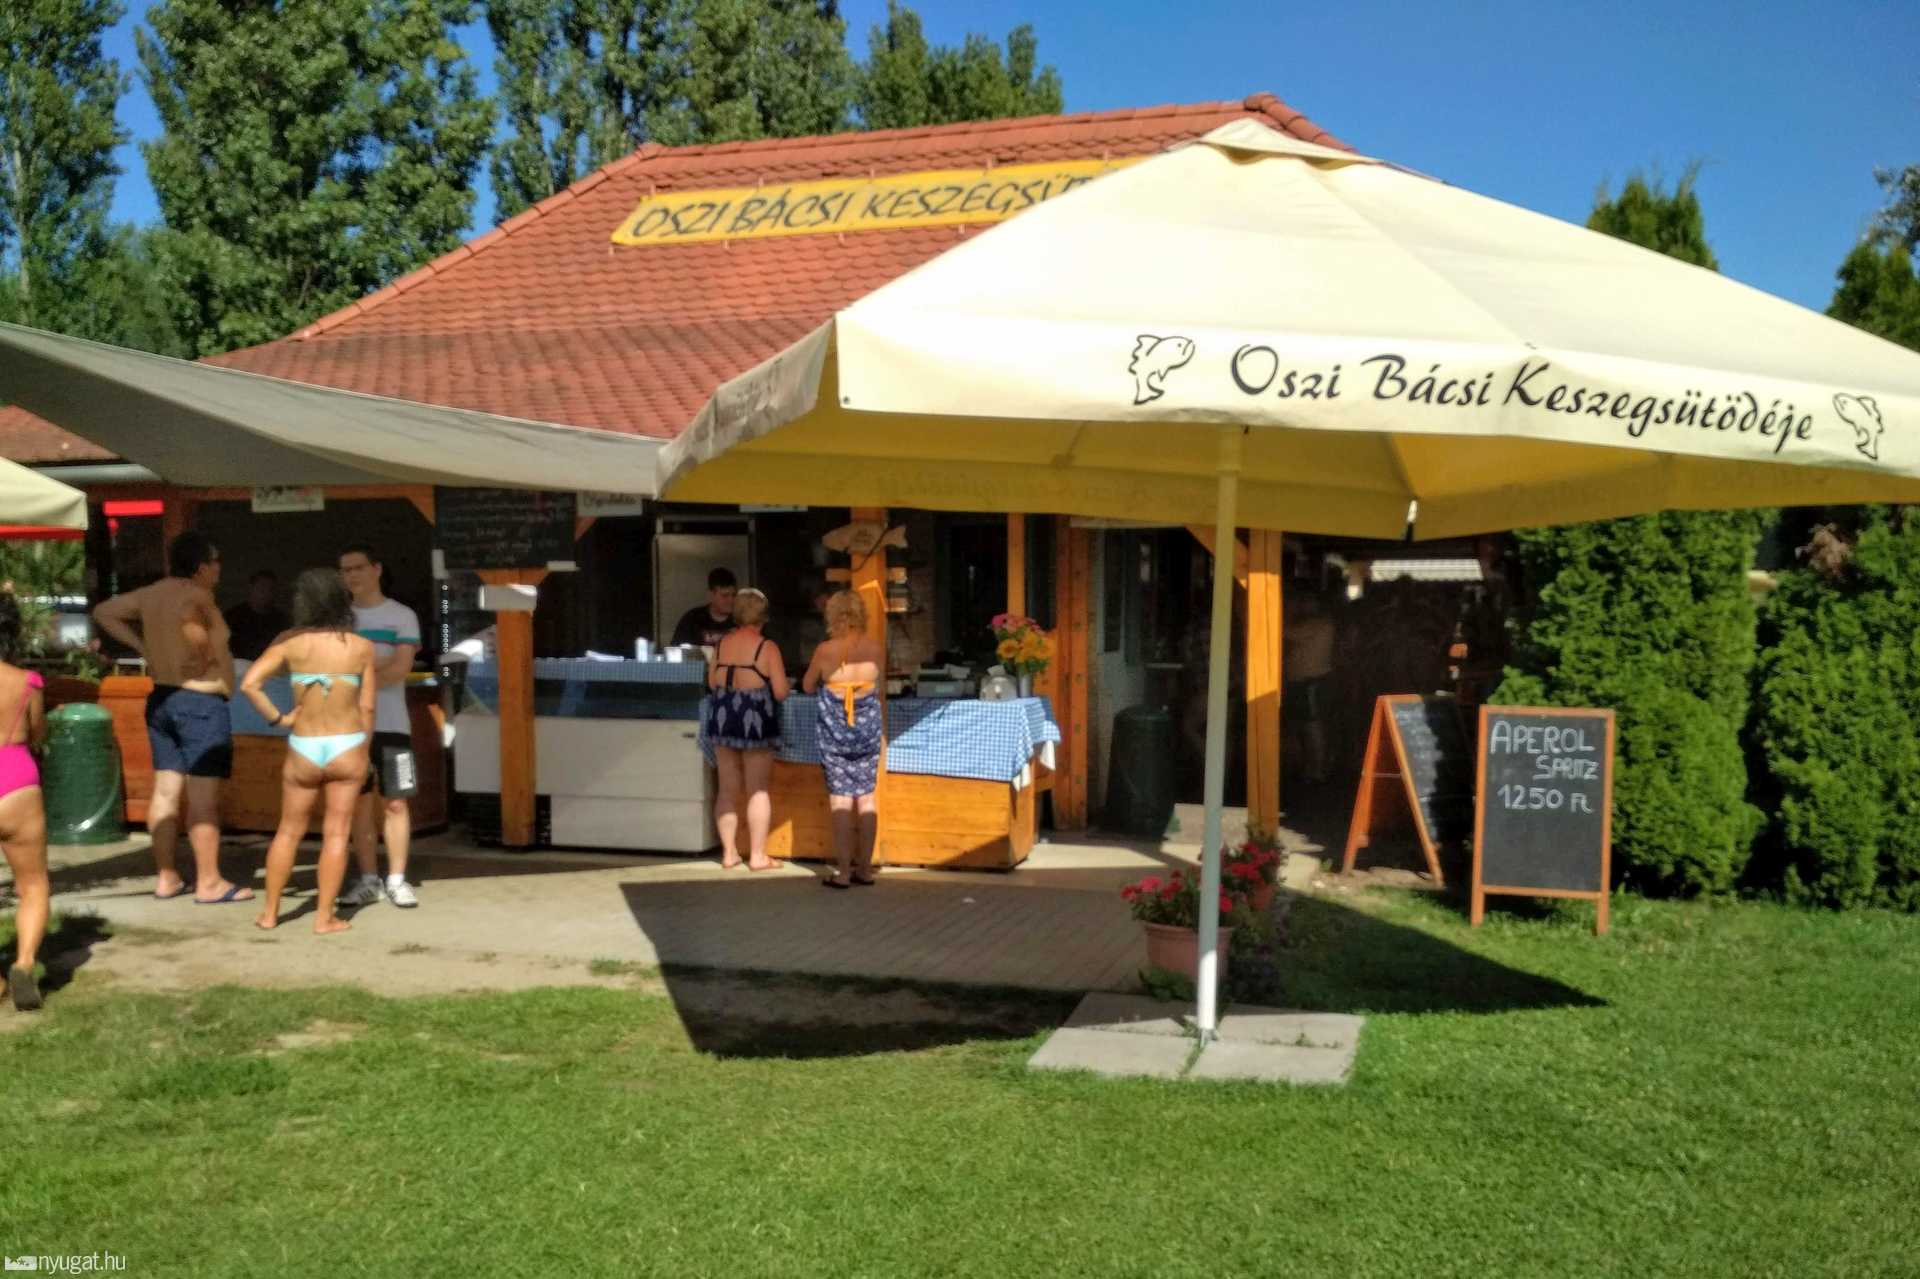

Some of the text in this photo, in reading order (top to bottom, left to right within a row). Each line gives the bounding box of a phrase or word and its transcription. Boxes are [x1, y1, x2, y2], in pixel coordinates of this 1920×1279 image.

[633, 202, 728, 237] OSZI
[727, 188, 853, 233] BÁCSI
[1231, 344, 1813, 454] Oszi Bácsi Keszegsütödéje
[1490, 720, 1595, 754] APEROL
[1497, 784, 1564, 810] 1250
